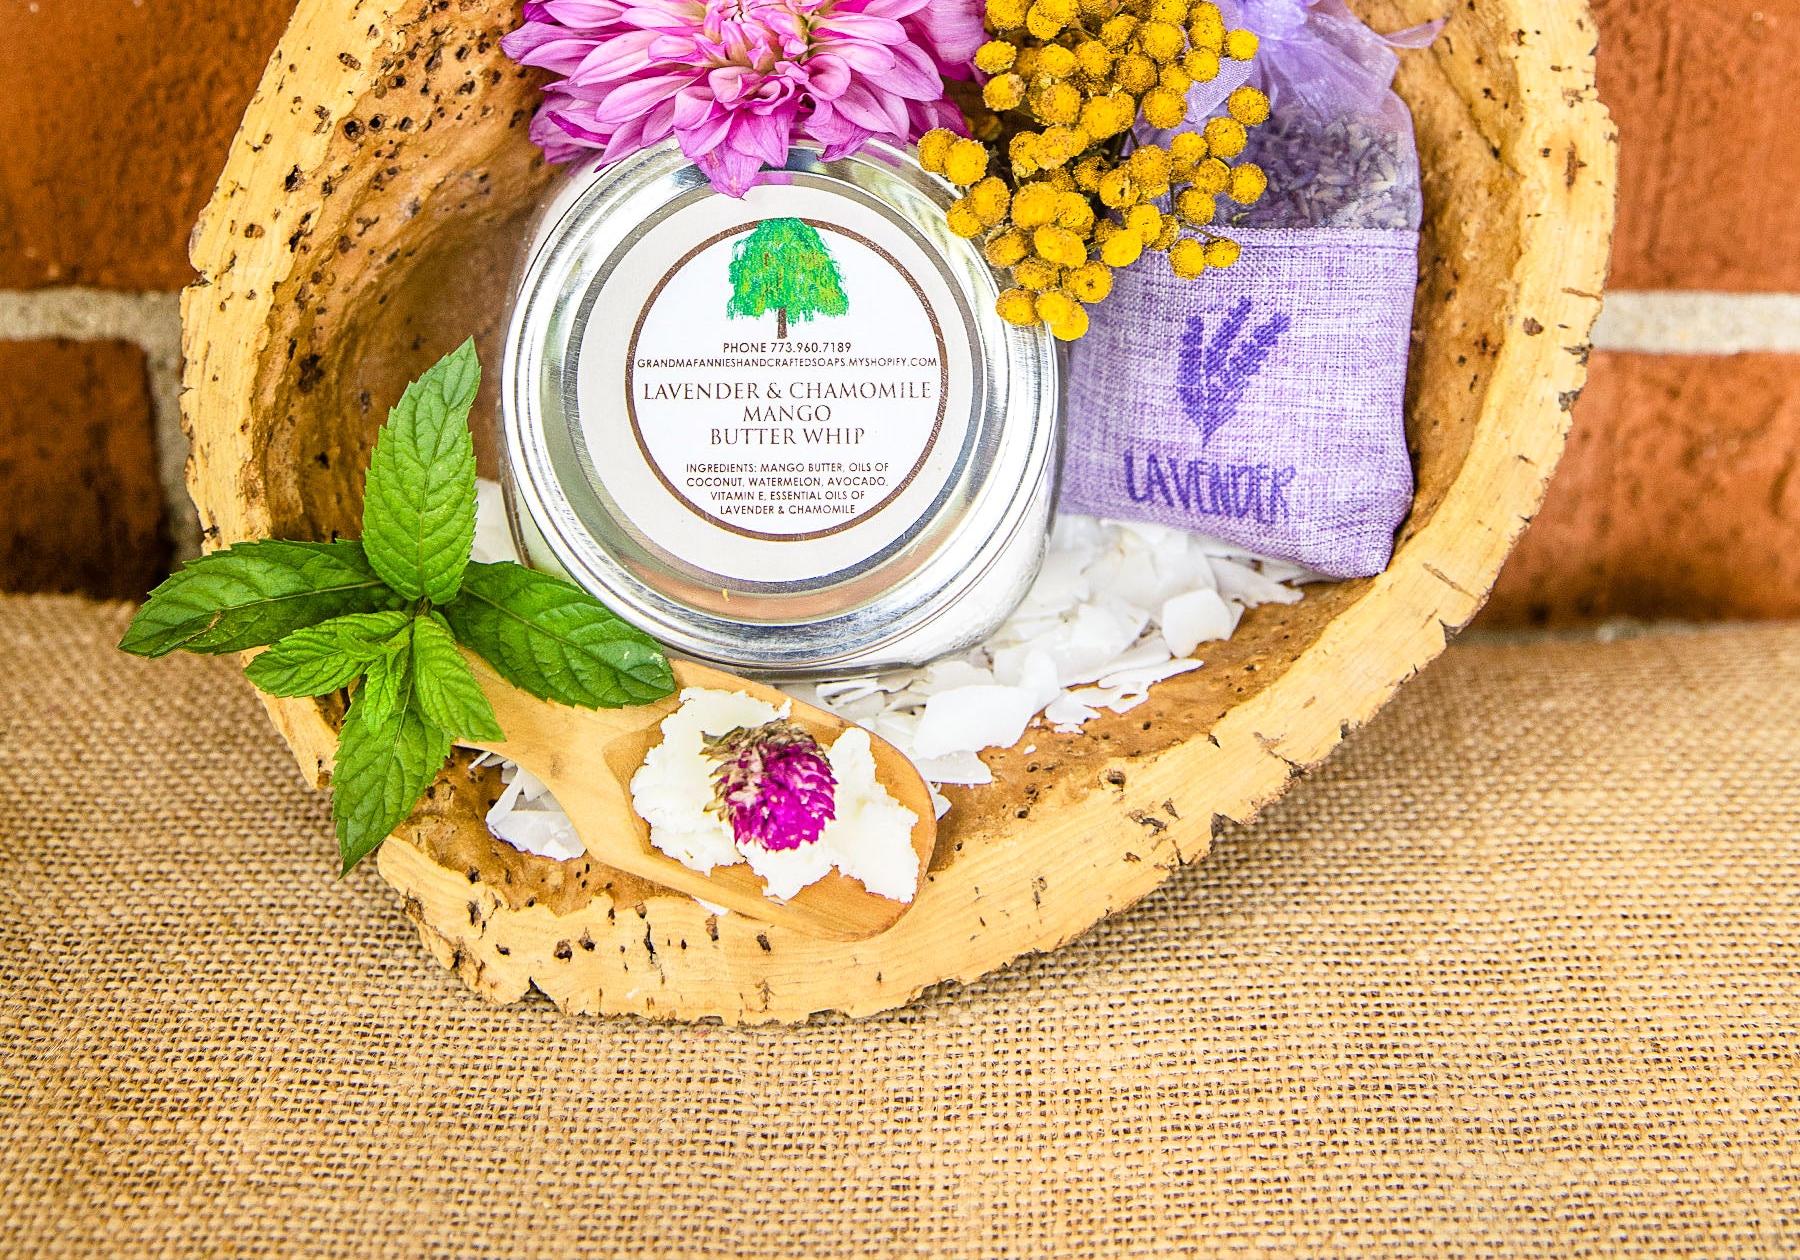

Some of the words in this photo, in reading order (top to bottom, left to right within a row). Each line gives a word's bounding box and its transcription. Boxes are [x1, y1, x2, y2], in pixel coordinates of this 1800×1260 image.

[723, 342, 767, 354] PHONE
[770, 341, 852, 354] 773.960.7189
[636, 357, 937, 369] GRANDMAFANNIESHANDCRAFTEDSOAPS.MYSHOPIFY.COM
[643, 382, 760, 400] LAVENDER
[766, 382, 782, 400] &
[789, 381, 932, 399] CHAMOMILE
[743, 404, 832, 422] MANGO
[711, 427, 797, 445] BUTTER
[802, 427, 865, 445] WHIP
[686, 463, 757, 474] INGREDIENTS:
[759, 462, 805, 473] MANGO
[848, 462, 872, 473] OILS
[874, 462, 889, 472] OF
[748, 476, 824, 487] WATERMELON,
[1123, 448, 1297, 525] LAVENDER
[710, 491, 755, 501] VITAMIN
[758, 491, 767, 502] E,
[770, 490, 822, 501] ESSENTIAL
[824, 490, 848, 501] OILS
[850, 490, 865, 500] OF
[720, 505, 775, 515] LAVENDER
[777, 505, 785, 515] &
[788, 504, 856, 515] CHAMOMILE
